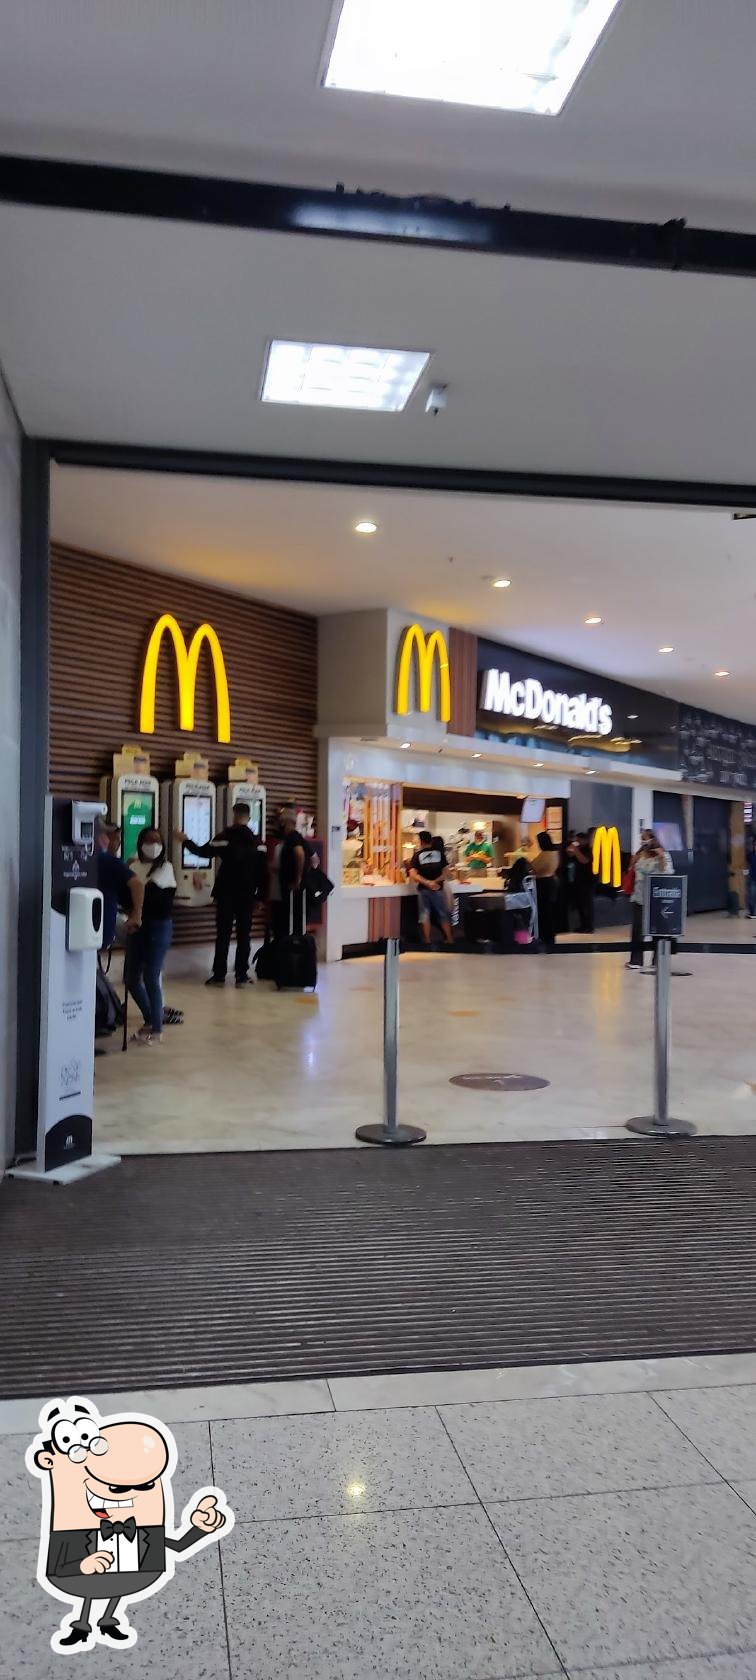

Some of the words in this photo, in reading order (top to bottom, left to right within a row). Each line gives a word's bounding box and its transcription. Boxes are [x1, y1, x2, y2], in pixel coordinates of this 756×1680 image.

[139, 613, 231, 743] M
[397, 623, 450, 722] M
[483, 668, 613, 735] McDonald's
[592, 826, 622, 888] M
